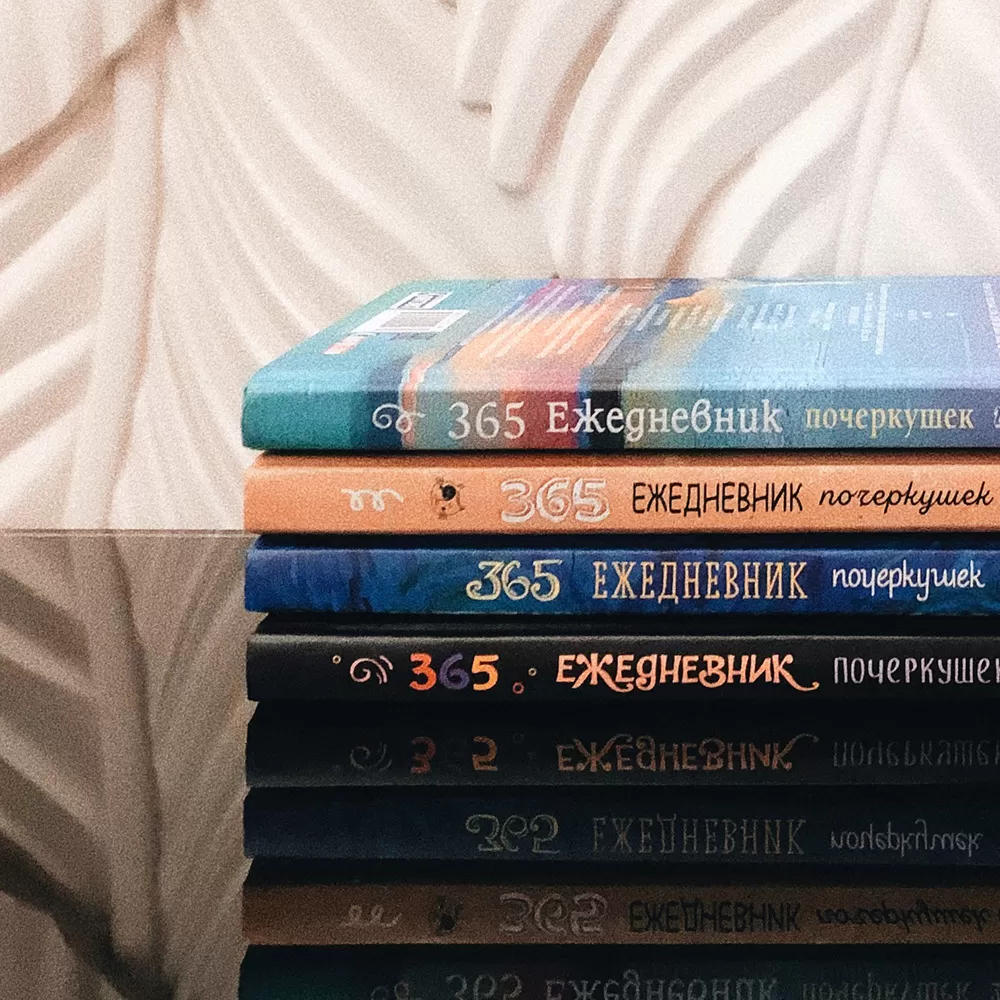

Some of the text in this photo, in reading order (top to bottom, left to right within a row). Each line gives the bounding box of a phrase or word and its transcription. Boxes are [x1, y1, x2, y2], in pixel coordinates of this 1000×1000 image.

[448, 401, 526, 440] 365
[546, 399, 784, 443] Ежедневник
[805, 406, 975, 438] почеркушек
[500, 476, 611, 523] 365
[632, 481, 804, 517] ЕЖЕДНЕВНИК
[819, 481, 994, 515] почеркушек
[466, 559, 563, 602] 365
[592, 561, 808, 605] ЕЖЕДНЕВНИК
[832, 560, 986, 601] почеркушек
[409, 653, 499, 691] 365
